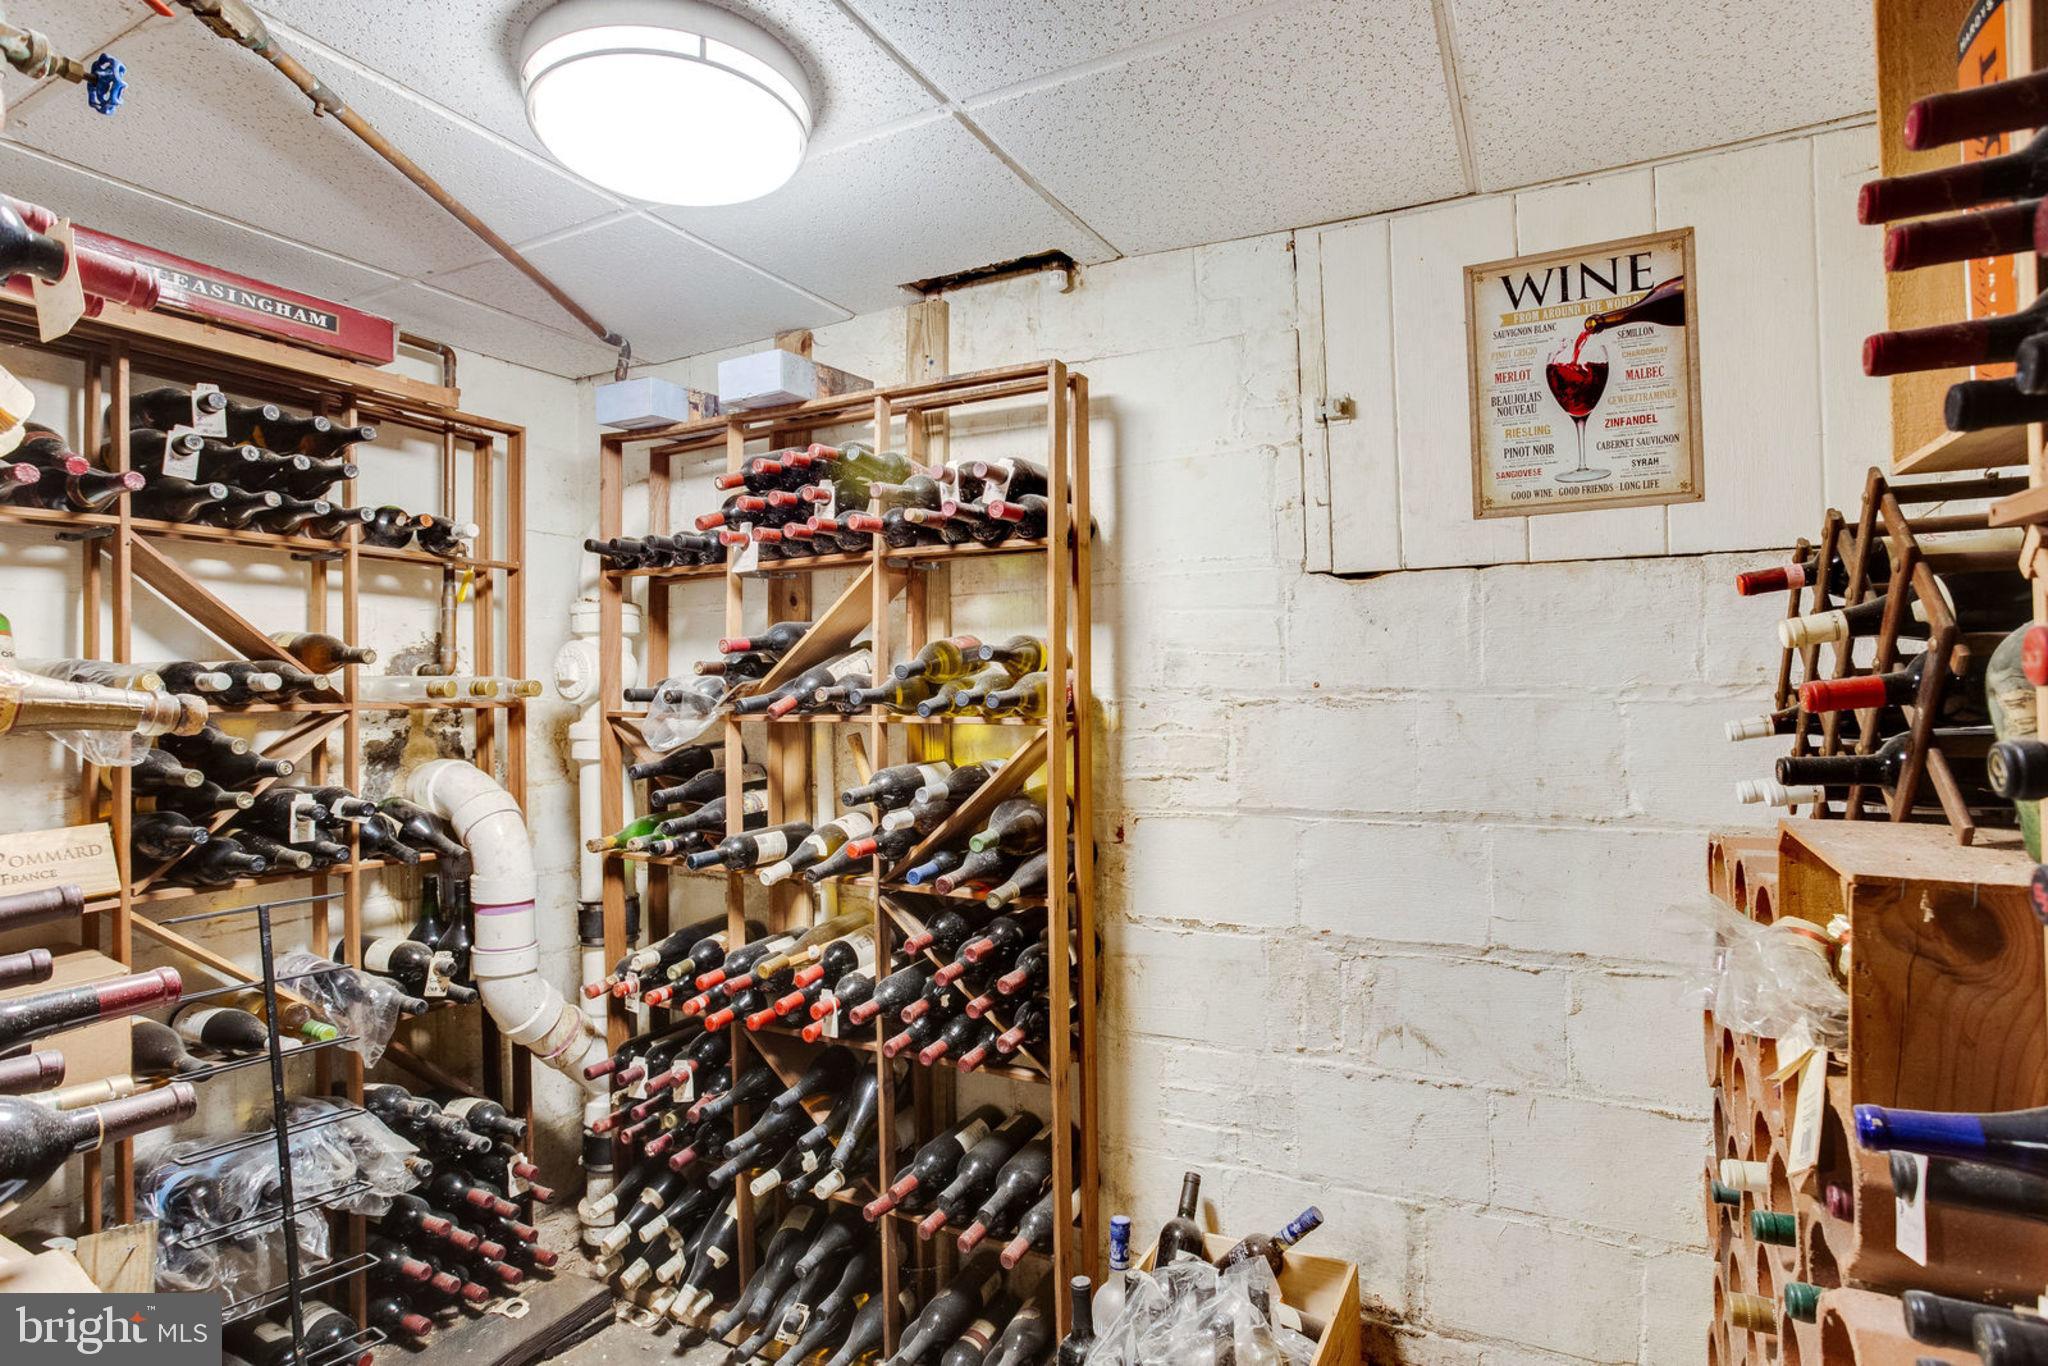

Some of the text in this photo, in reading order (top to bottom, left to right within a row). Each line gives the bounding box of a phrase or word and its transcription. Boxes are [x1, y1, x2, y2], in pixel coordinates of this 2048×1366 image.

[1499, 251, 1654, 310] WINE
[1513, 295, 1640, 324] FROM AROUND THE WORLD
[1493, 323, 1557, 339] SAUVIGNON BLANC
[1621, 346, 1668, 358] CHARDONNAY
[1495, 368, 1531, 384] MERLOT
[1625, 365, 1665, 380] MALBEC
[1491, 391, 1542, 407] BEAUJOLAIS
[1497, 403, 1537, 417] NOUVEAU
[1604, 413, 1658, 428] ZINFANDEL
[1504, 424, 1551, 439] RIESLING
[1596, 433, 1680, 451] CABERNET SAUVIGNON
[1503, 443, 1555, 459] PINOT NOIR
[1631, 457, 1659, 468] SYRAH
[1495, 468, 1542, 480] SANGIOVESE
[1511, 478, 1660, 500] GOOD WINE GOOD FRIENDS LONG LIFE
[1, 869, 58, 886] FRANCE
